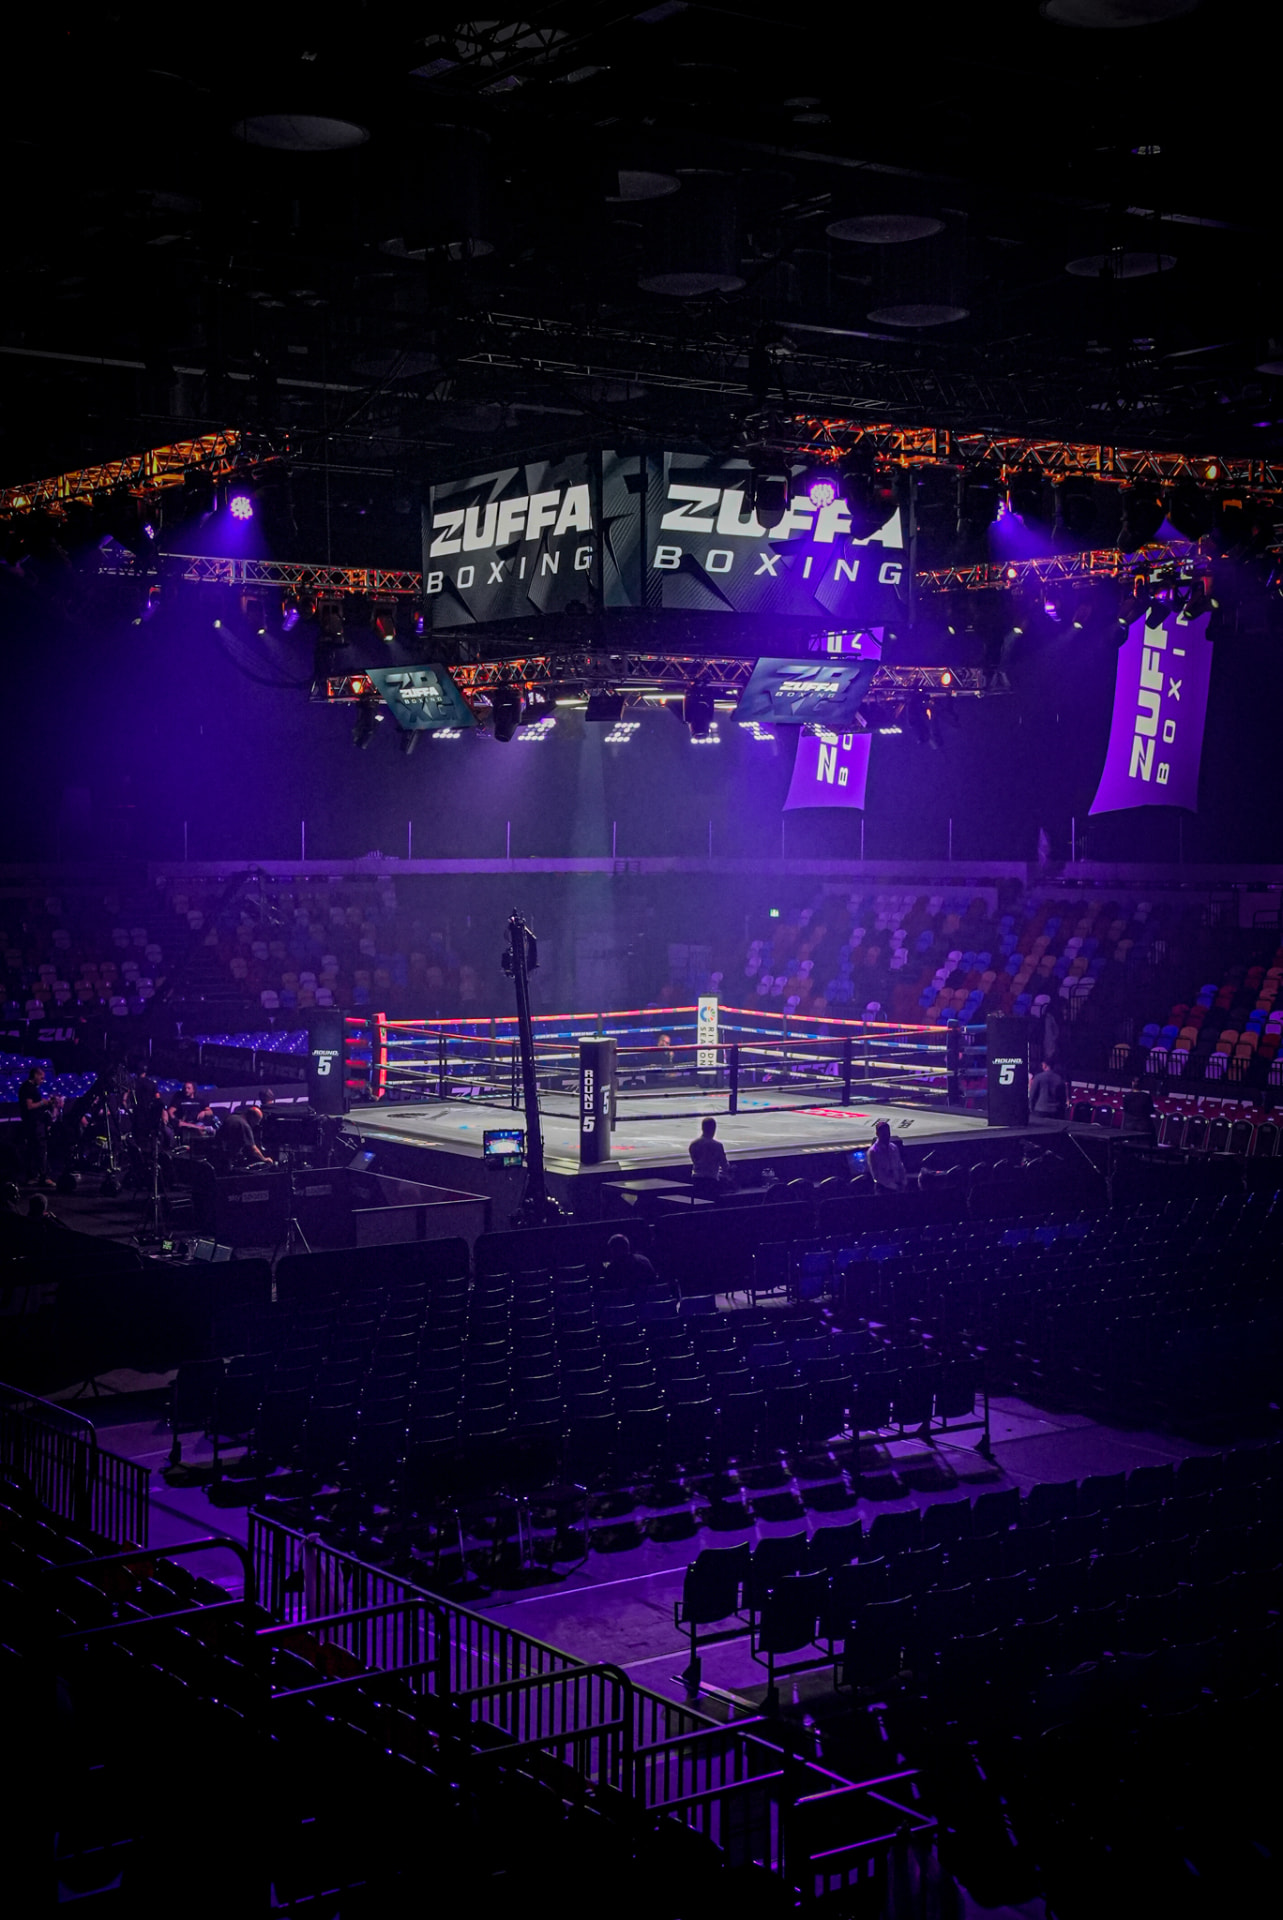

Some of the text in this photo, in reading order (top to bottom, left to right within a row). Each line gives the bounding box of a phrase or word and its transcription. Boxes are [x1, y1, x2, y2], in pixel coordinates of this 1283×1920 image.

[430, 484, 592, 557] ZUFFA
[427, 546, 592, 593] BOXING
[653, 545, 903, 585] BOXING
[779, 681, 839, 692] ZUFFA
[1129, 561, 1171, 782] ZUFF
[400, 686, 439, 698] ZUFFA
[404, 696, 442, 704] BOXING
[317, 1056, 332, 1075] 5
[699, 1026, 707, 1066] SEAON
[999, 1065, 1016, 1085] 5
[582, 1069, 596, 1133] ROUND 5
